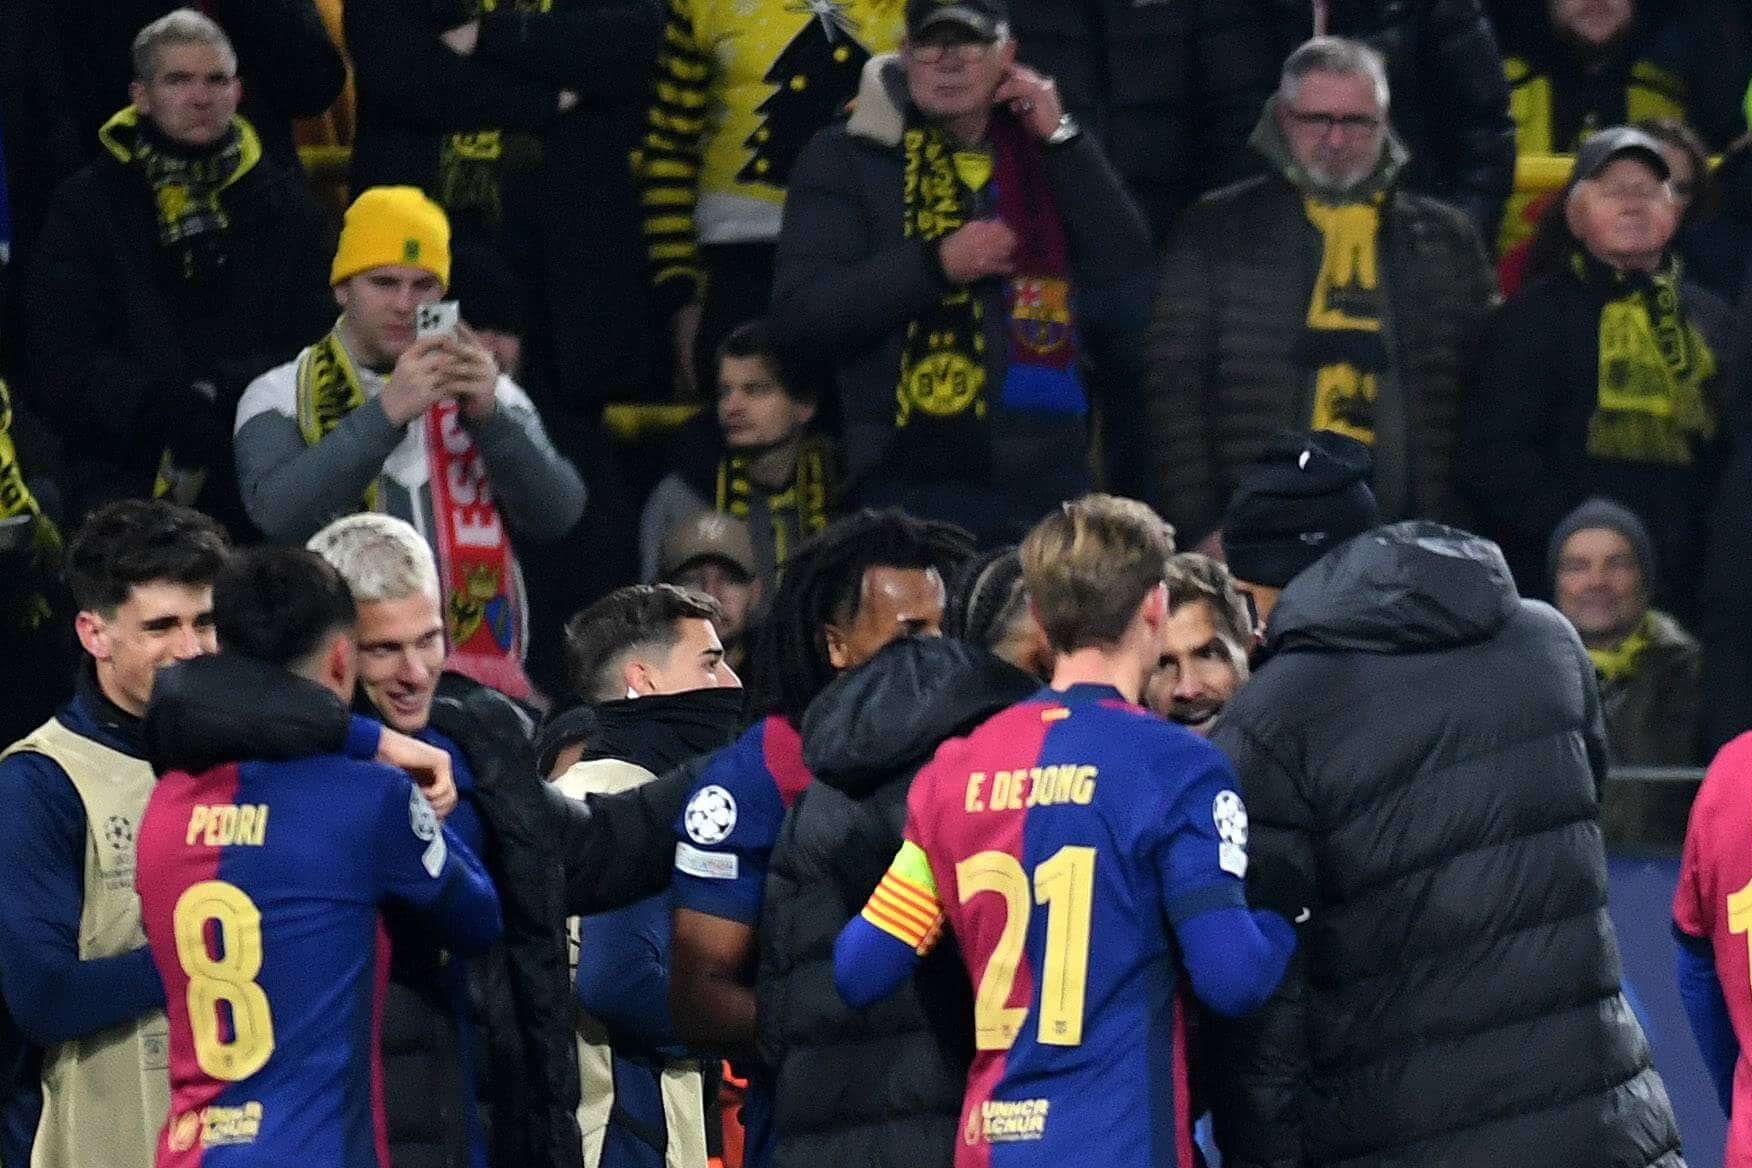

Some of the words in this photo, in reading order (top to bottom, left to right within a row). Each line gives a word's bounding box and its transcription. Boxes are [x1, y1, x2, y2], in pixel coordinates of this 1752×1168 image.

[185, 803, 269, 847] PEDRI
[989, 769, 1028, 811] DE
[1026, 764, 1098, 807] JONG
[173, 880, 275, 1082] 8
[955, 845, 1097, 1050] 21
